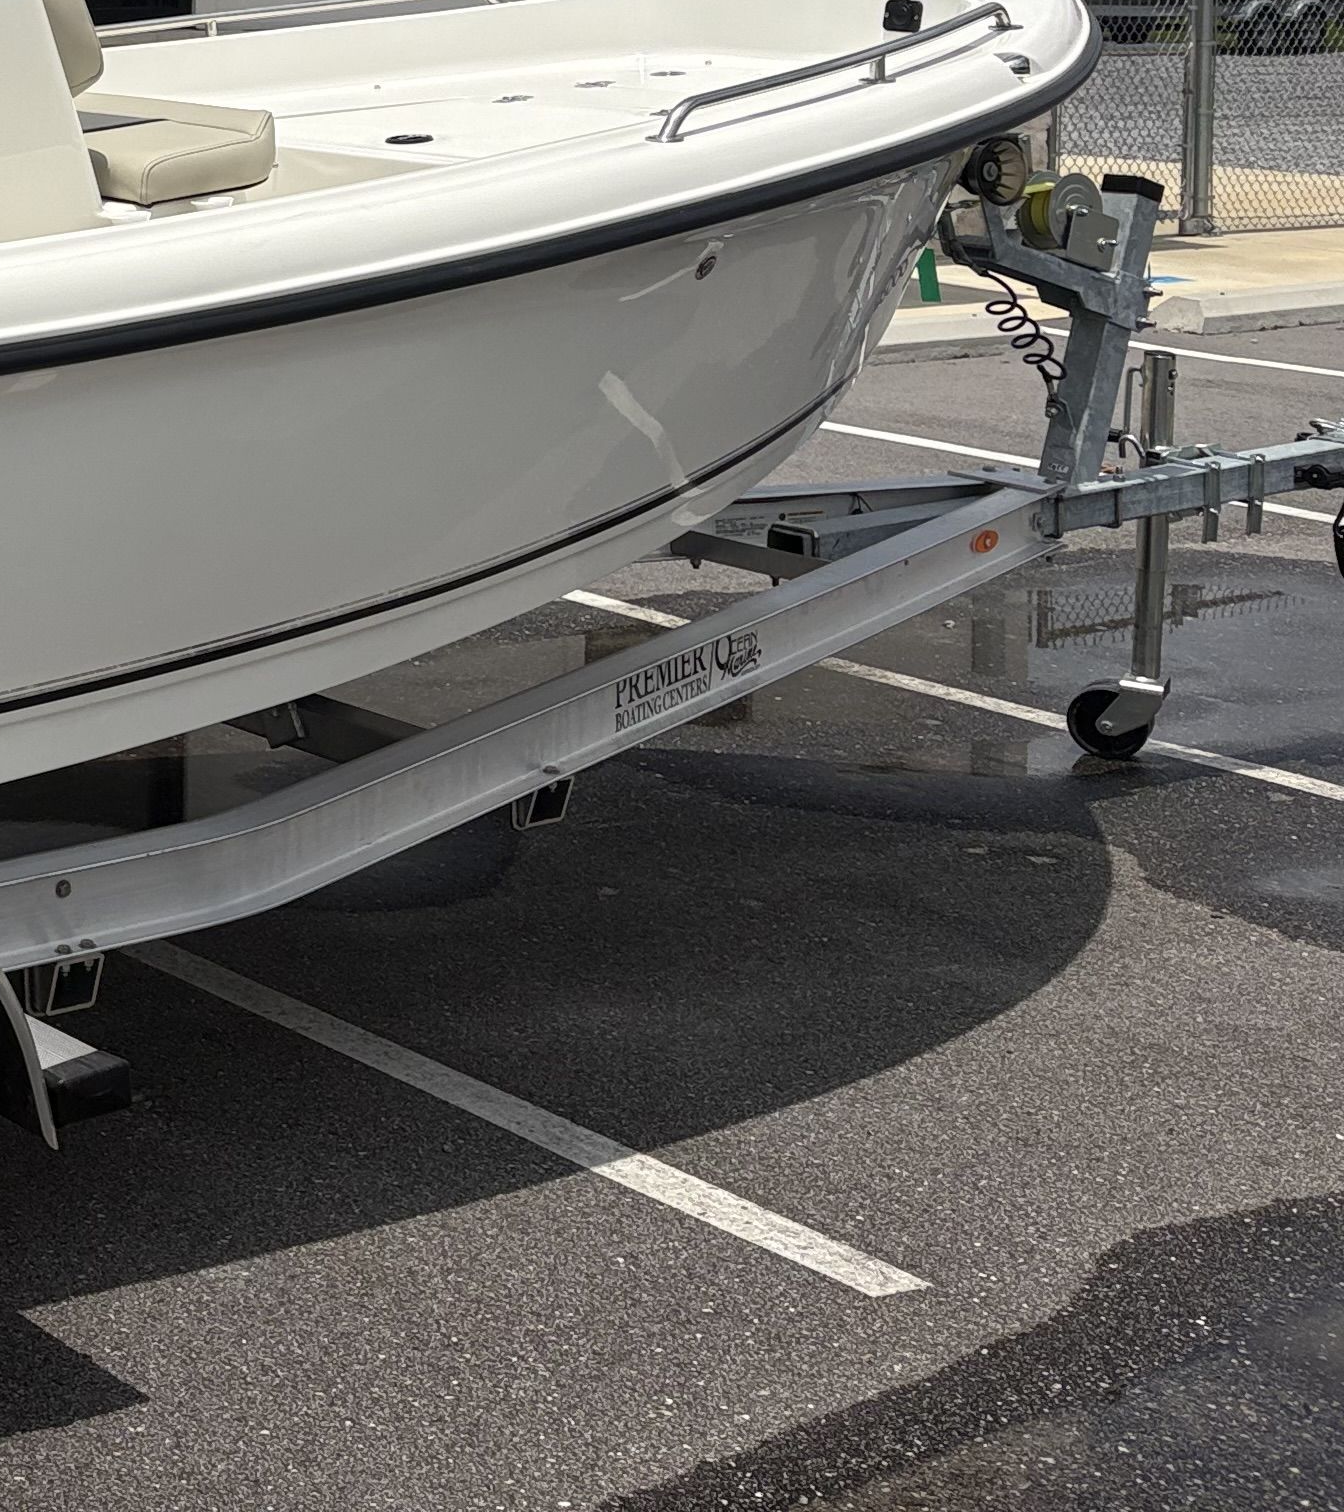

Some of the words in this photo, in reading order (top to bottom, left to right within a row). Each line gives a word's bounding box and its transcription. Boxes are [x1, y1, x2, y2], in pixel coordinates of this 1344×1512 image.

[614, 646, 708, 710] PREMIER
[614, 692, 662, 733] BOATING
[662, 674, 709, 712] CENTERS
